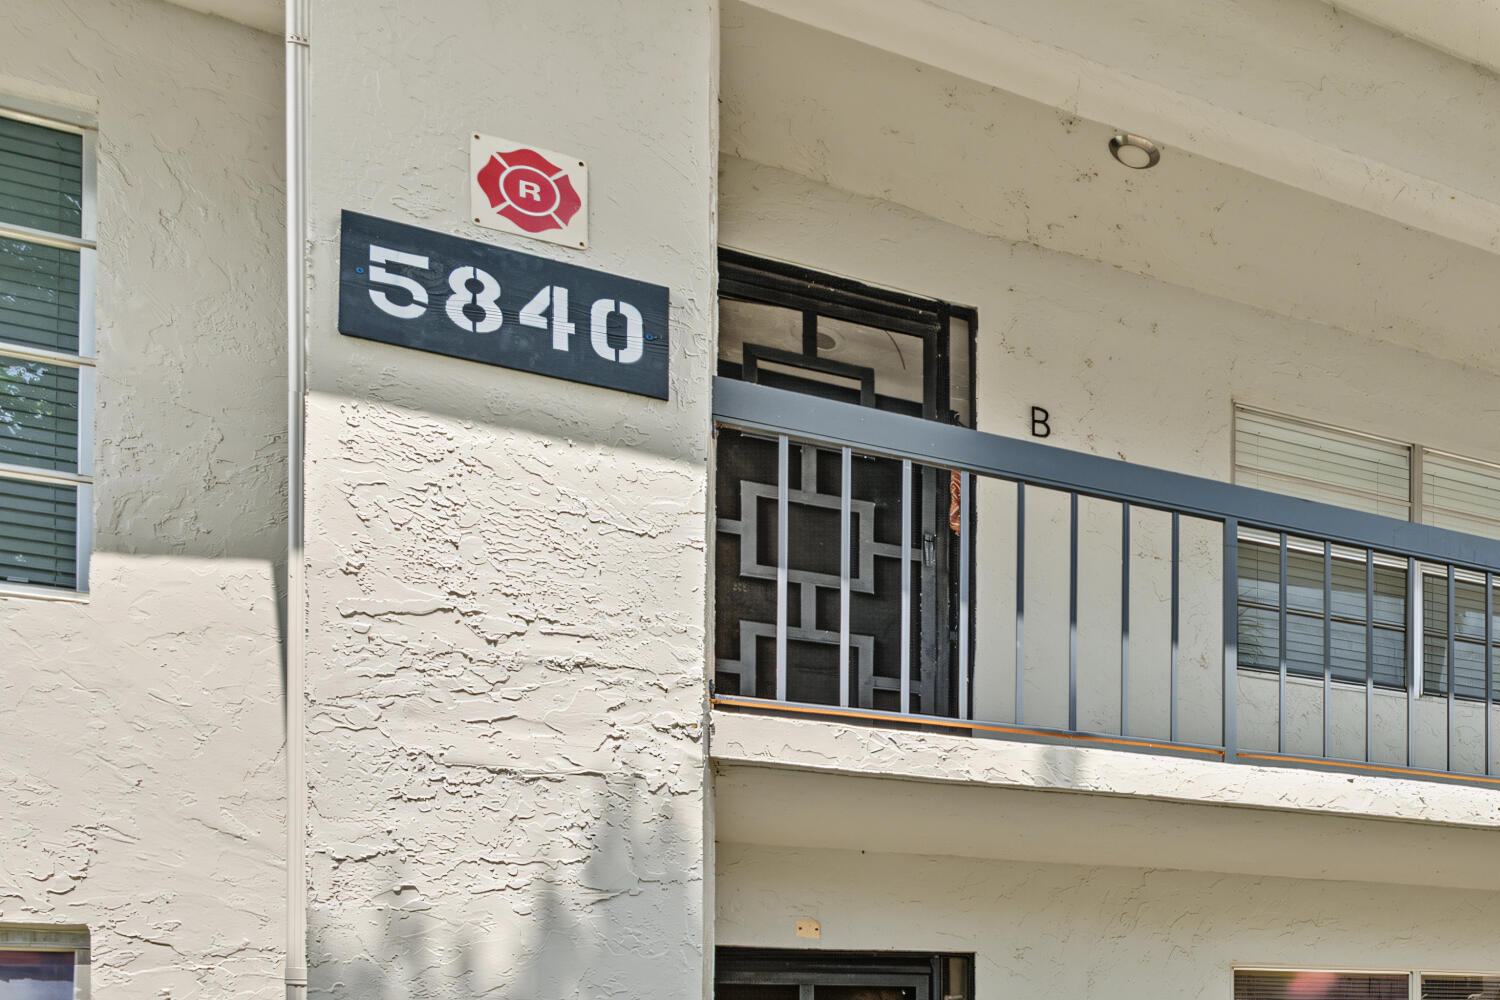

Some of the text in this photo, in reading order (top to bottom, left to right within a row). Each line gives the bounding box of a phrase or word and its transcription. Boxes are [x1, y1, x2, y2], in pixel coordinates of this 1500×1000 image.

[518, 179, 541, 202] R
[368, 243, 644, 364] 5840
[1031, 405, 1051, 438] B
